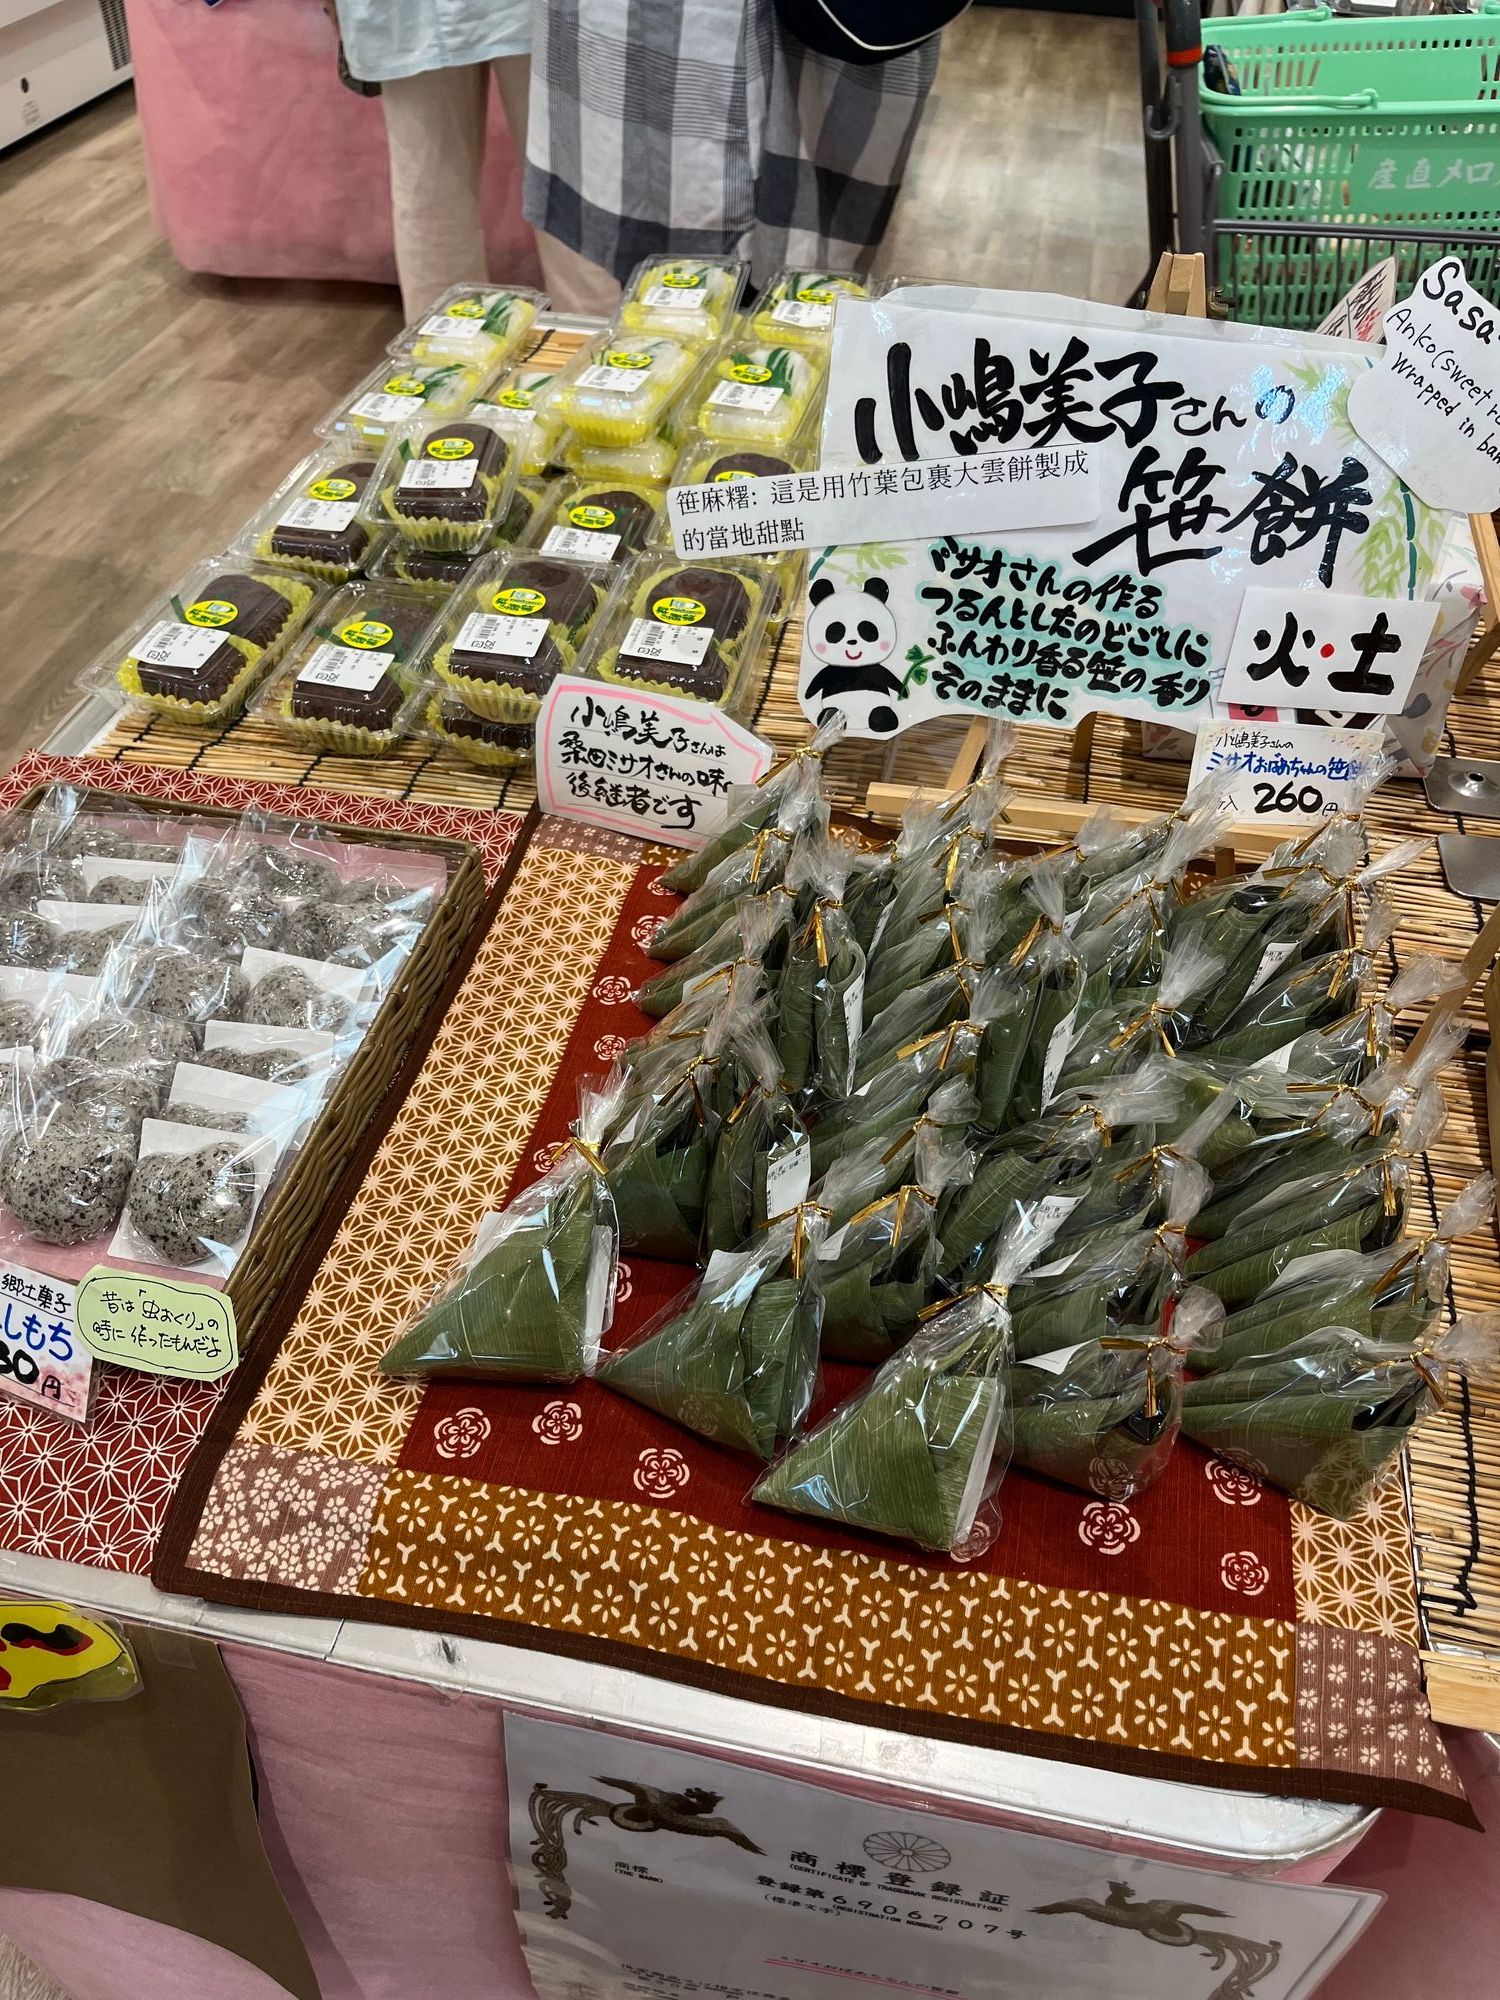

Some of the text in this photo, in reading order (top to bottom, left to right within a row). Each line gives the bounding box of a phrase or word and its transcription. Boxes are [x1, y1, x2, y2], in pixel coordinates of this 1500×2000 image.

[1366, 157, 1500, 190] 産直メロ
[1423, 261, 1500, 345] Sasa
[1458, 417, 1475, 438] in
[682, 517, 805, 552] 的當地甜點
[1073, 446, 1374, 589] 笹餅
[931, 661, 1069, 720] そのままに
[564, 770, 703, 830] 後継者です
[1252, 780, 1338, 816] 260円
[1, 1273, 72, 1314] 郷土菓子
[0, 1302, 74, 1362] しもち
[790, 1849, 1010, 1906] 商標登録証
